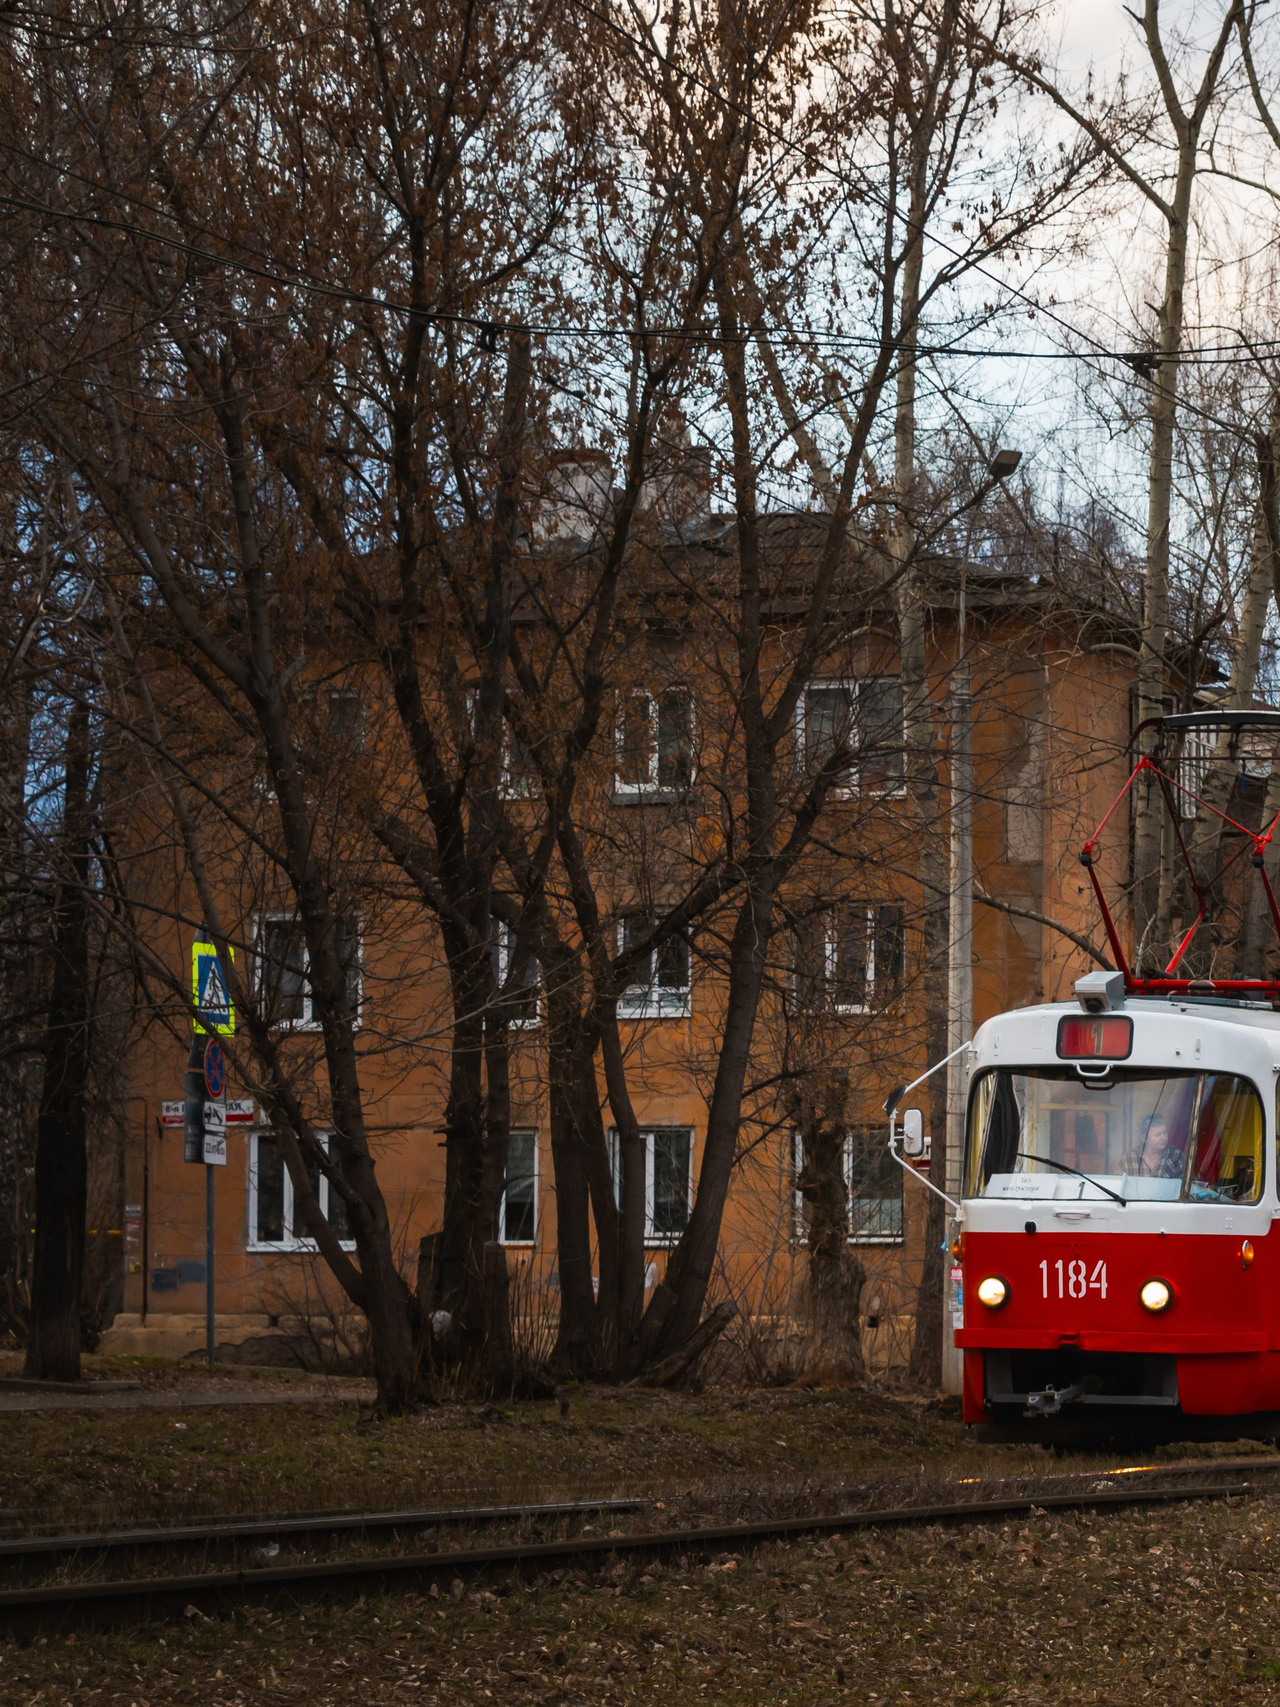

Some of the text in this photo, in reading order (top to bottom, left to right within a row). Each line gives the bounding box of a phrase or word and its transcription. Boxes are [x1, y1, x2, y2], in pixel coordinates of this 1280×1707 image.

[1091, 1020, 1104, 1056] 1
[1079, 1181, 1086, 1199] 1
[1039, 1259, 1108, 1299] 1184
